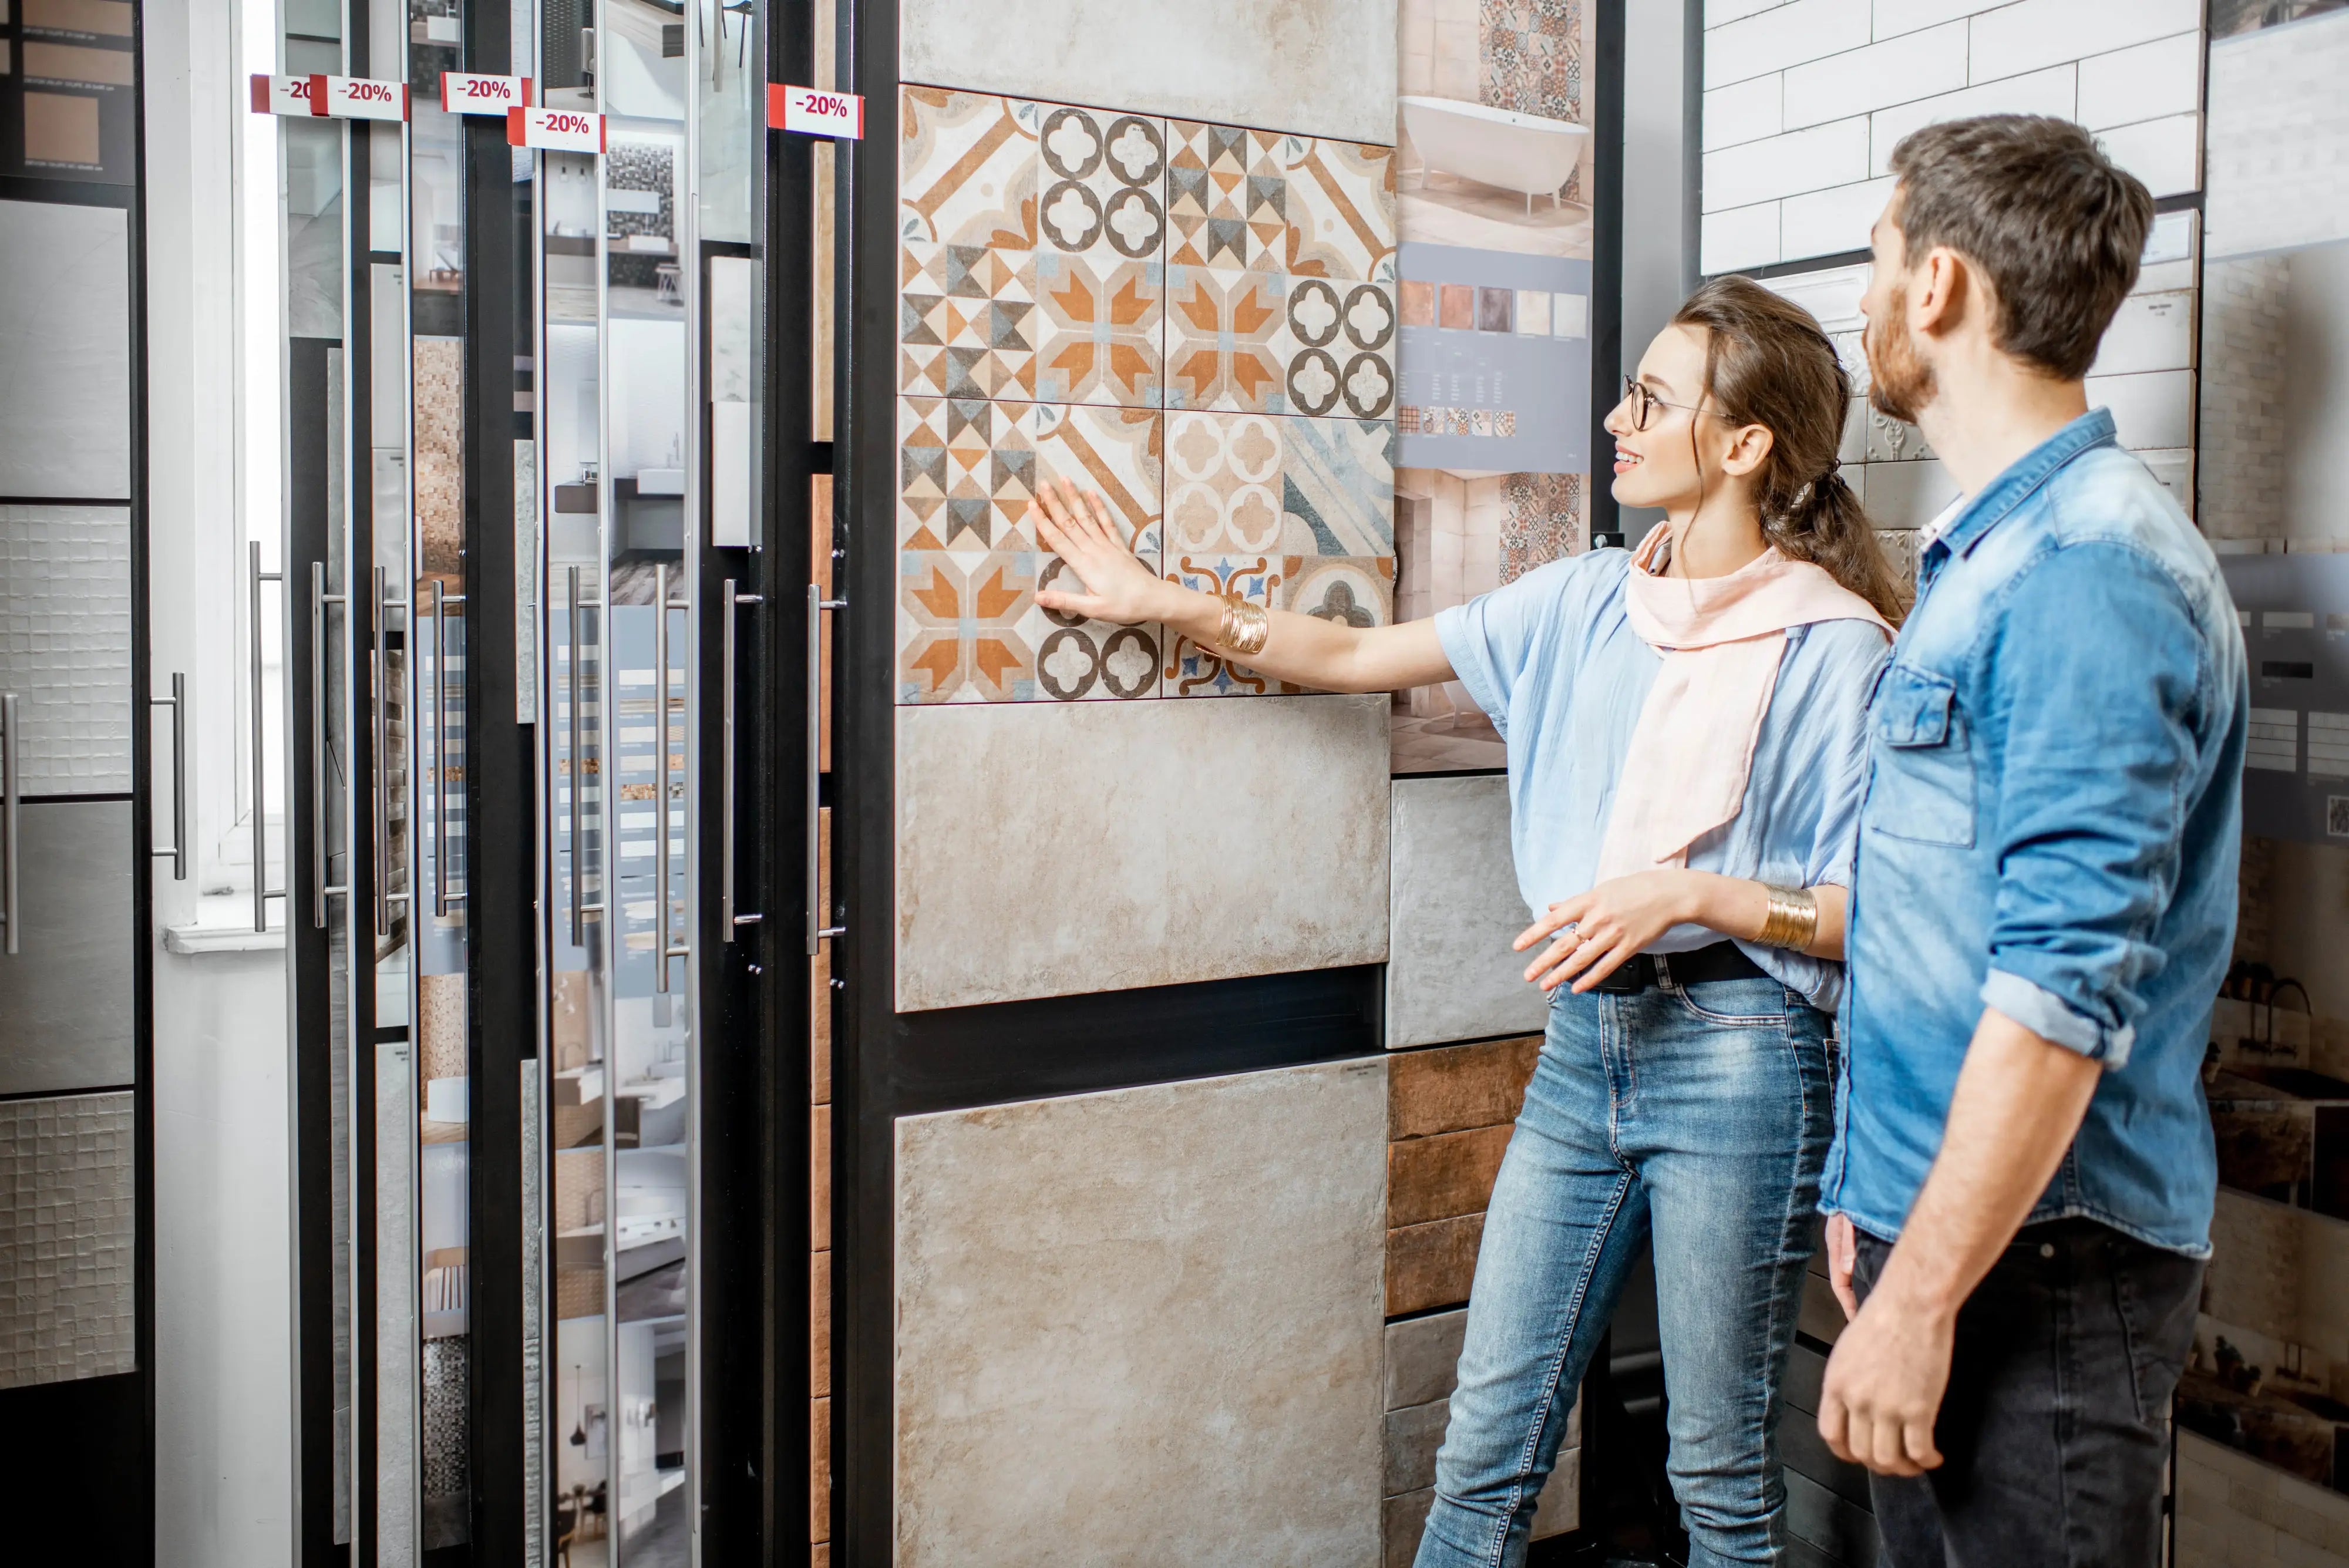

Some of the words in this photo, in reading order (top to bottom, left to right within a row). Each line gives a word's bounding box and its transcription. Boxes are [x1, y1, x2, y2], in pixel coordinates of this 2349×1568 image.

[280, 80, 311, 99] -20
[338, 82, 392, 102] -20%
[458, 80, 511, 99] -20%
[795, 94, 848, 118] -20%
[537, 114, 589, 134] -20%
